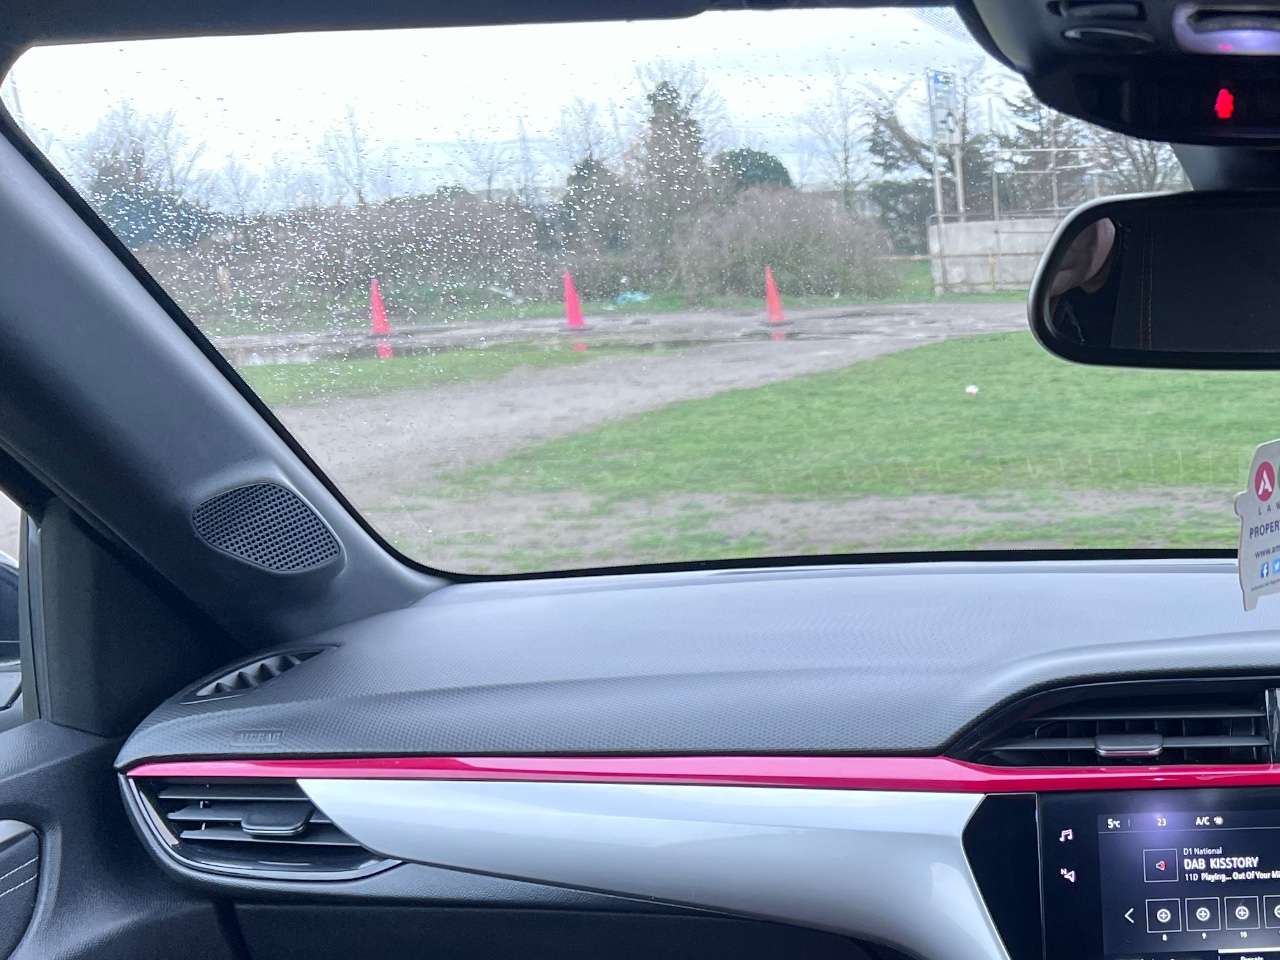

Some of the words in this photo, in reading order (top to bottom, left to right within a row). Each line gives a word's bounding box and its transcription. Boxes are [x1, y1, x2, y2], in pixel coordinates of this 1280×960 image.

[1196, 816, 1210, 826] A/C
[1183, 848, 1193, 856] D1
[1194, 847, 1222, 855] National
[1184, 858, 1206, 870] DAB
[1210, 857, 1259, 869] KISSTORY
[1233, 871, 1245, 880] Out
[1246, 870, 1255, 879] Of
[1256, 871, 1271, 879] Your
